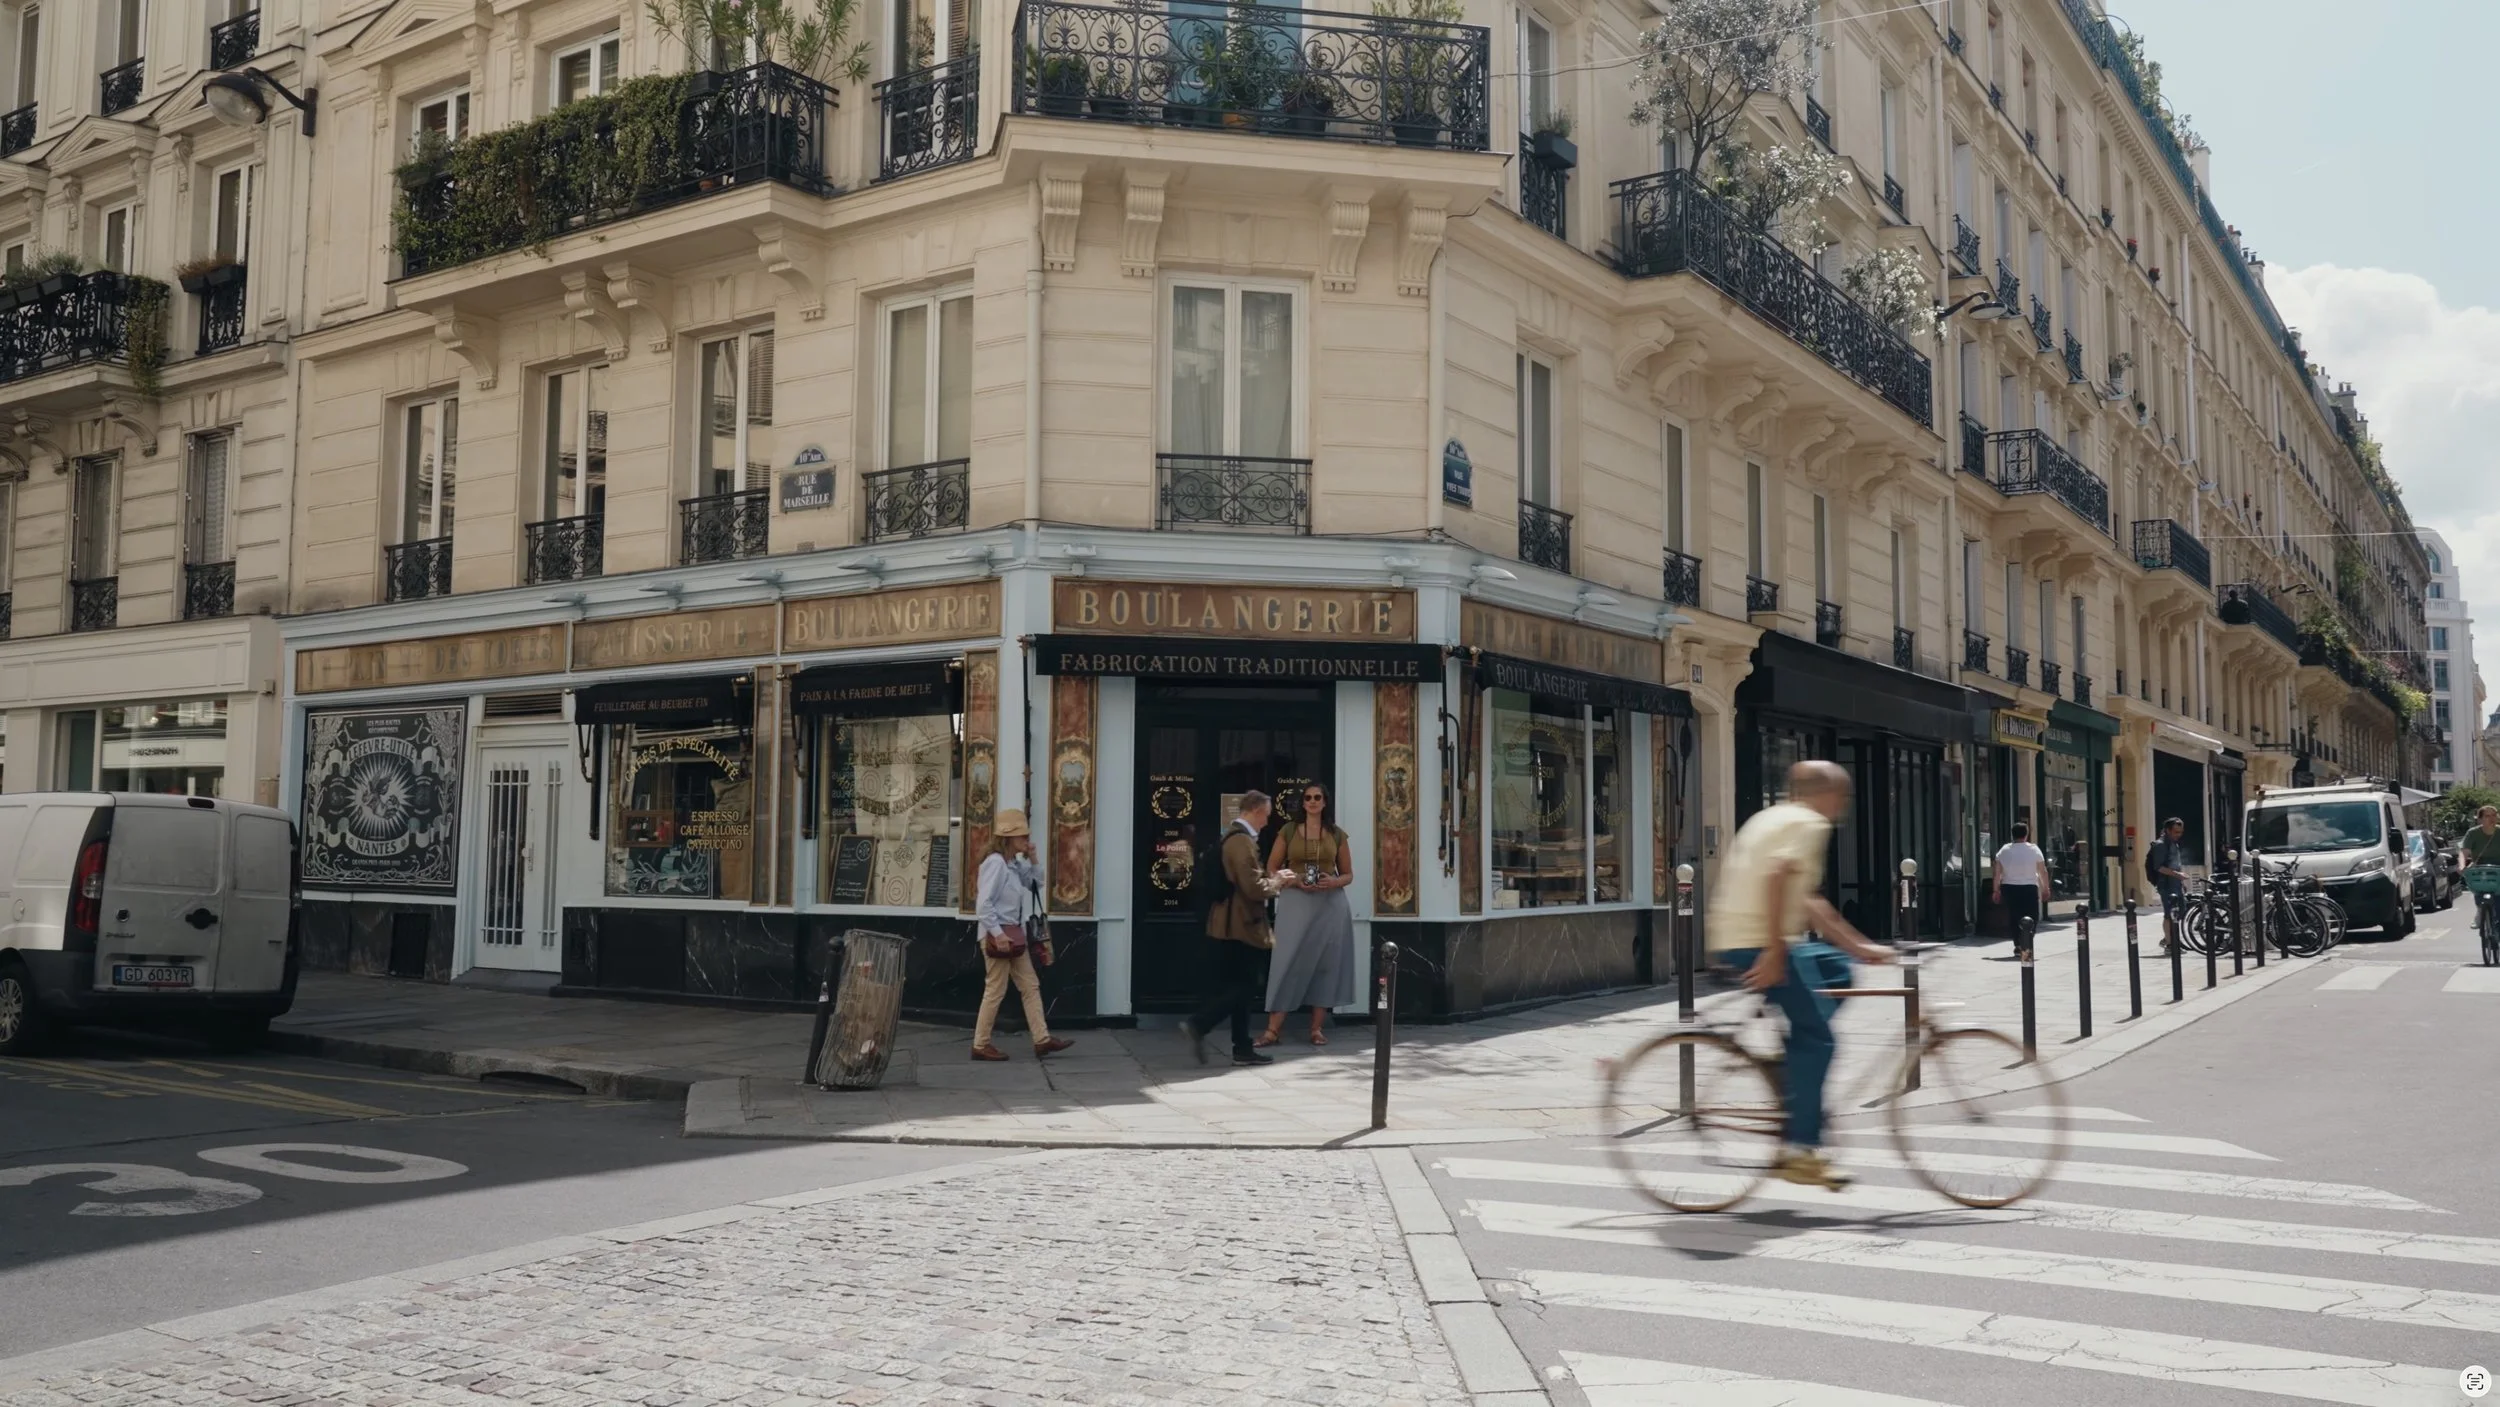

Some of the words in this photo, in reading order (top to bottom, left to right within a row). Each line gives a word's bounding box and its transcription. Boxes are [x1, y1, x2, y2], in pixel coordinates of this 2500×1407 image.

[798, 474, 817, 486] RUE
[802, 485, 814, 495] DE
[784, 493, 830, 508] MARSEILLE
[794, 592, 992, 643] BOULANGERIE
[1076, 589, 1395, 637] BOULANGERIE
[586, 616, 748, 658] PATISSERIE
[1060, 651, 1218, 677] FABRICATION
[1223, 654, 1421, 680] TRADITIONNELLE
[1496, 663, 1589, 701] BOULANGERIE
[800, 690, 822, 702] PAIN
[833, 689, 847, 701] LA
[849, 686, 882, 699] FARINE
[884, 685, 897, 697] DE
[594, 700, 647, 713] FEUILLETAGE
[648, 699, 659, 710] AU
[661, 698, 694, 710] BEURRE
[695, 697, 709, 708] FIN
[658, 739, 674, 754] DE
[691, 810, 739, 822] ESPRESSO
[355, 838, 397, 854] NANTES
[686, 838, 742, 850] CAPPUCCINO
[1156, 844, 1166, 852] Le
[1166, 844, 1187, 852] Point
[124, 967, 144, 981] GD
[148, 969, 190, 982] 603YR
